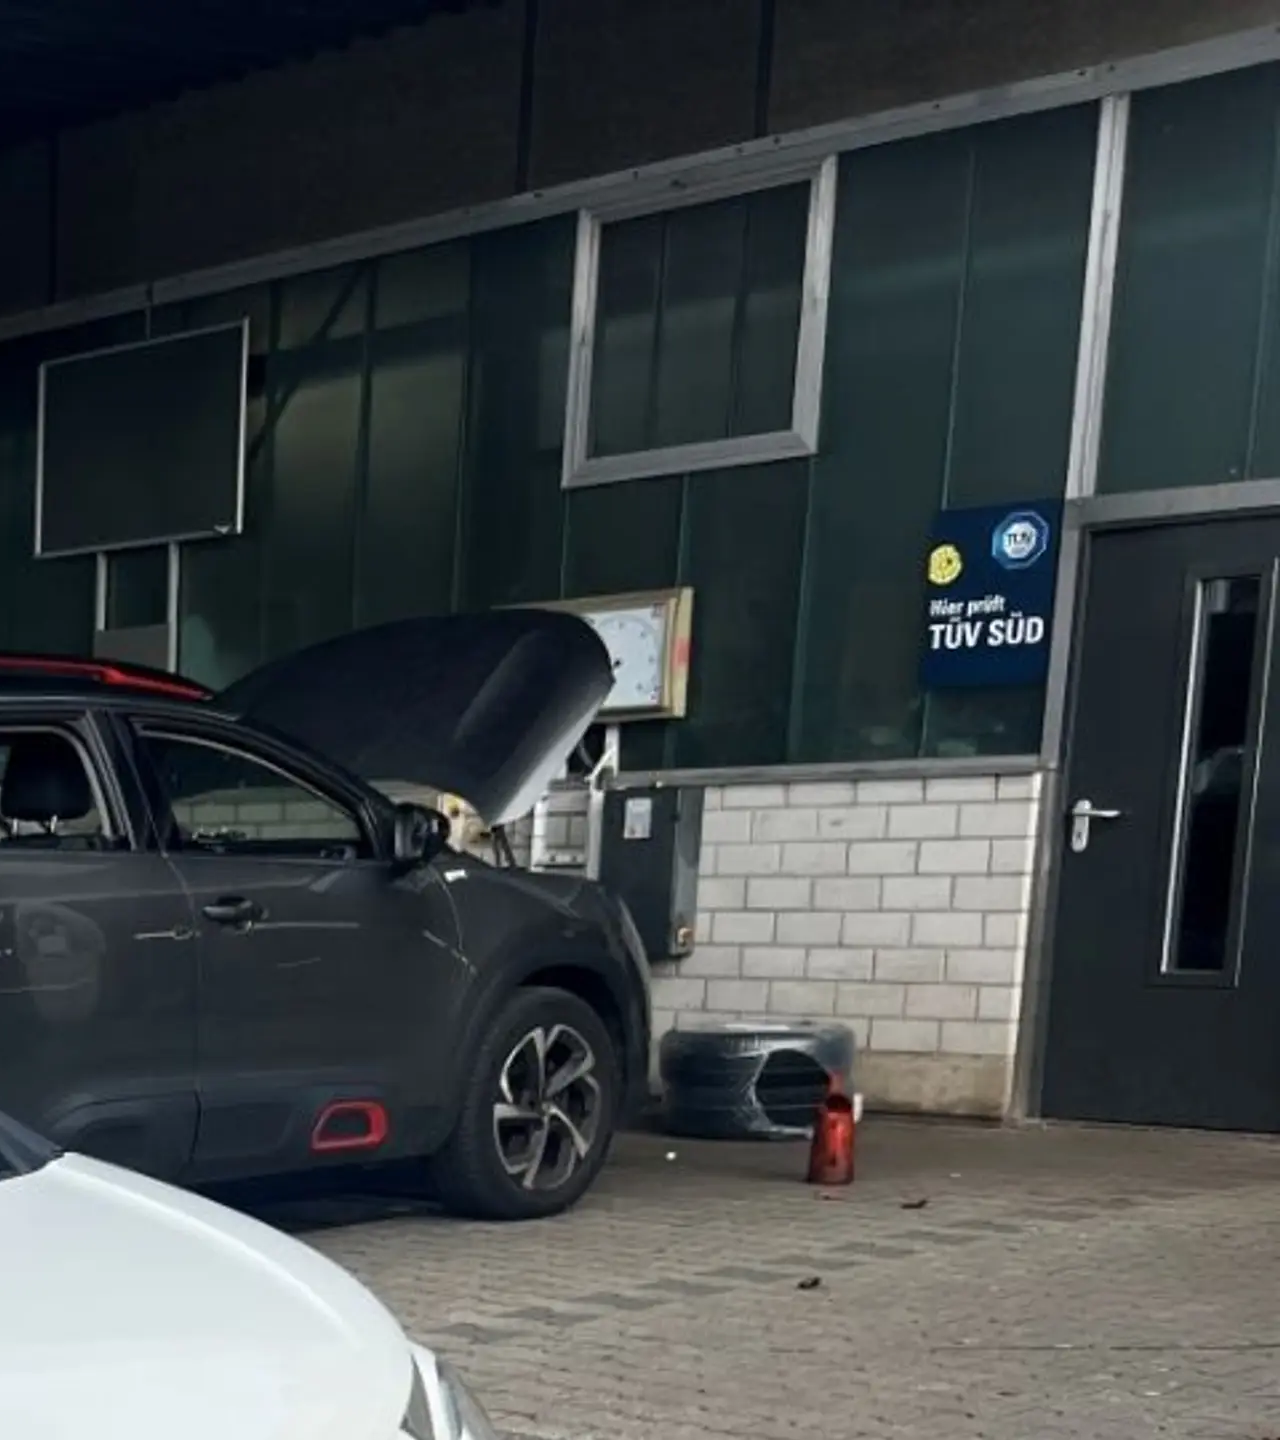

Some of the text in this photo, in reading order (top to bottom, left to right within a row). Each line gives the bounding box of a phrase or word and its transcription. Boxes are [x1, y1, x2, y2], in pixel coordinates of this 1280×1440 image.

[929, 593, 1006, 618] Hier prüft
[928, 610, 1045, 650] TÜV SÜD
